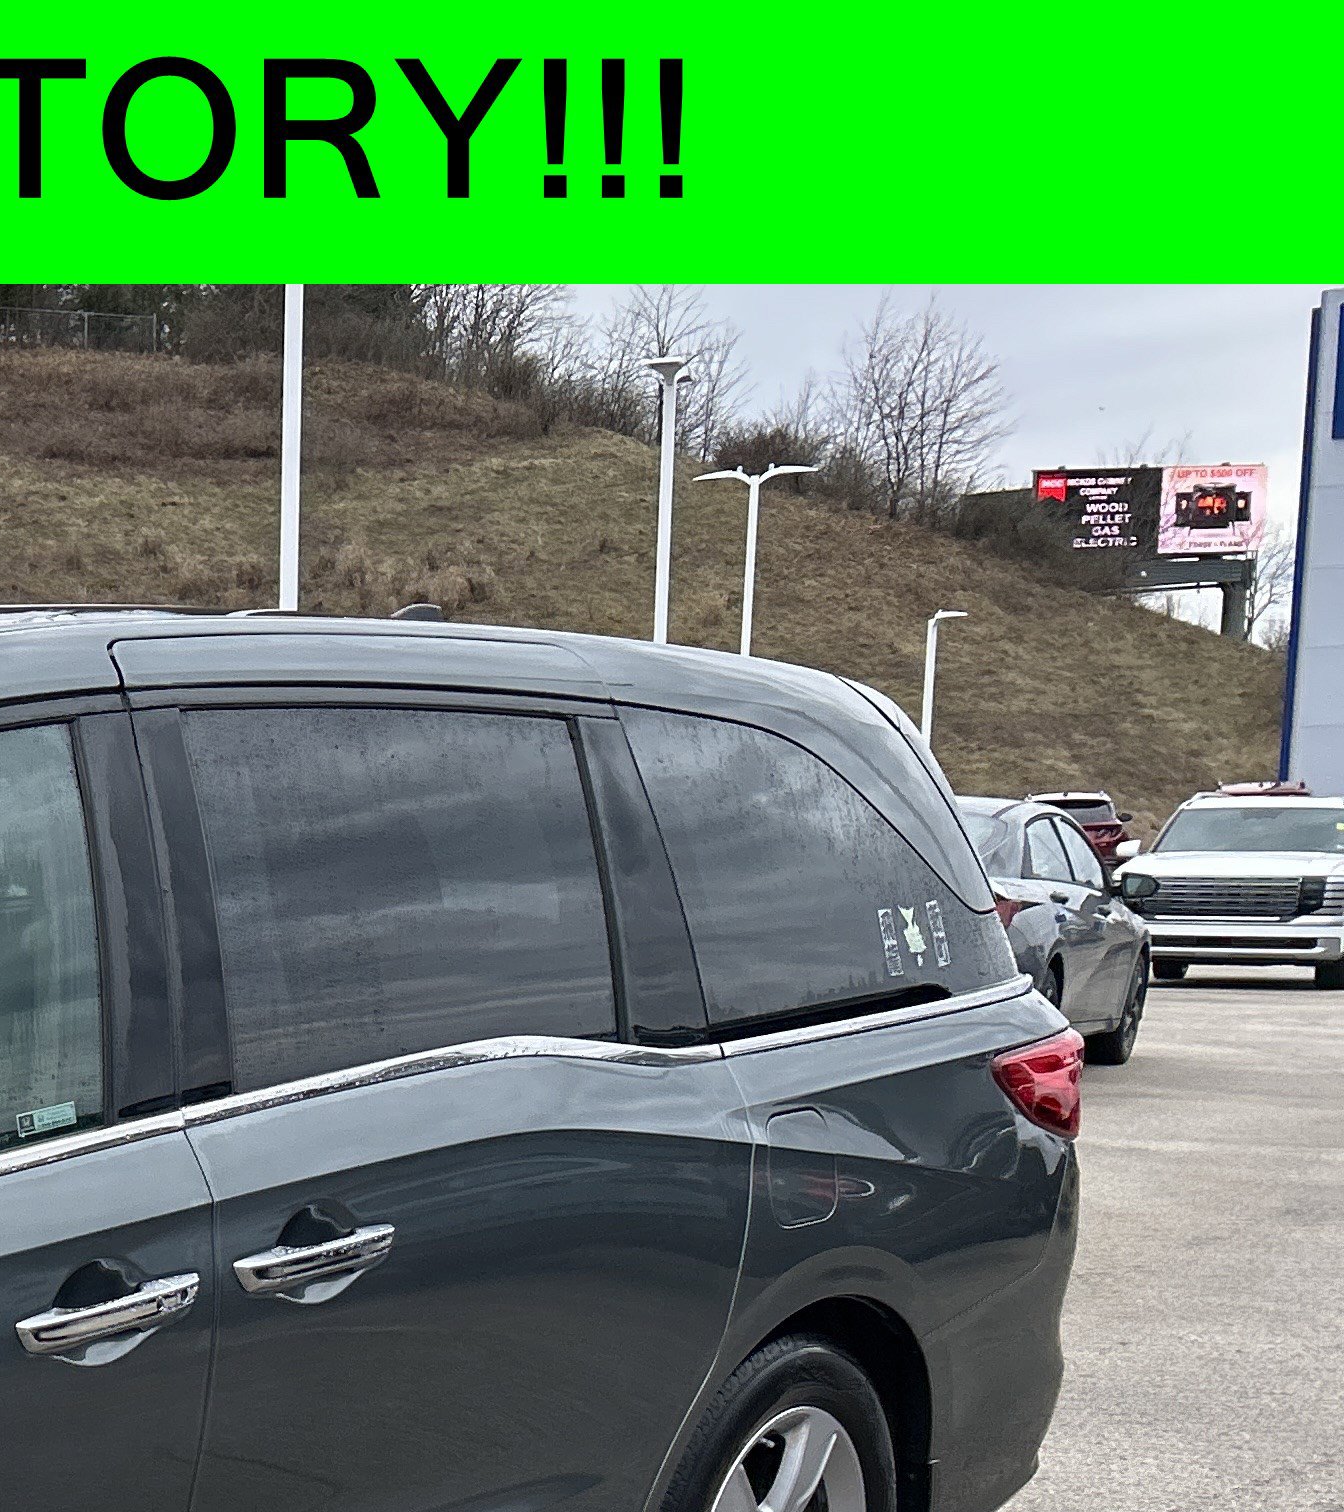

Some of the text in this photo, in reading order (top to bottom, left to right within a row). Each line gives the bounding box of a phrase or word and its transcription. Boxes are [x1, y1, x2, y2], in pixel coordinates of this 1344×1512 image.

[1178, 470, 1192, 479] UP
[1194, 470, 1208, 479] TO
[1236, 468, 1255, 477] OFF
[1086, 503, 1129, 513] WOOD
[1081, 514, 1132, 524] PELLET
[1092, 526, 1120, 536] GAS
[1072, 537, 1137, 548] ELECTRIC
